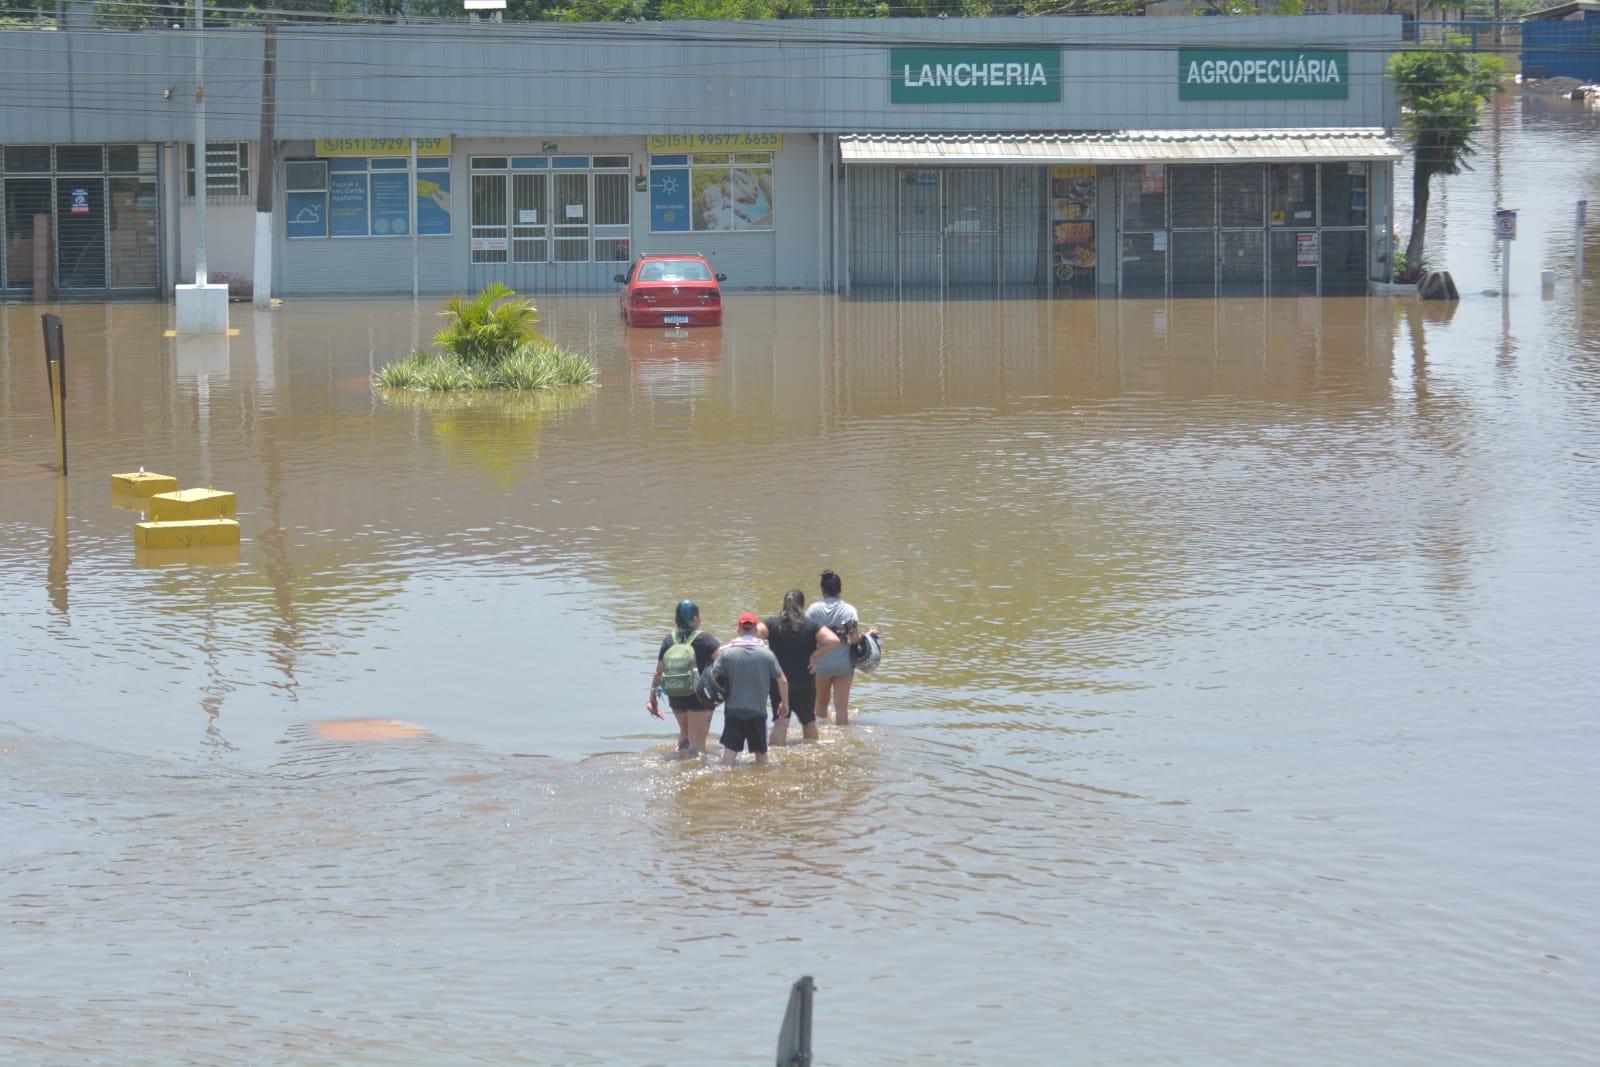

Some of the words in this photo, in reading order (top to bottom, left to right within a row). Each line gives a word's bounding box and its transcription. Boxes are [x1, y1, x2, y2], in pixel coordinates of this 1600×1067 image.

[904, 63, 1047, 87] LANCHERIA
[1186, 54, 1340, 84] AGROPECUÁRIA
[370, 138, 441, 150] 2929.559
